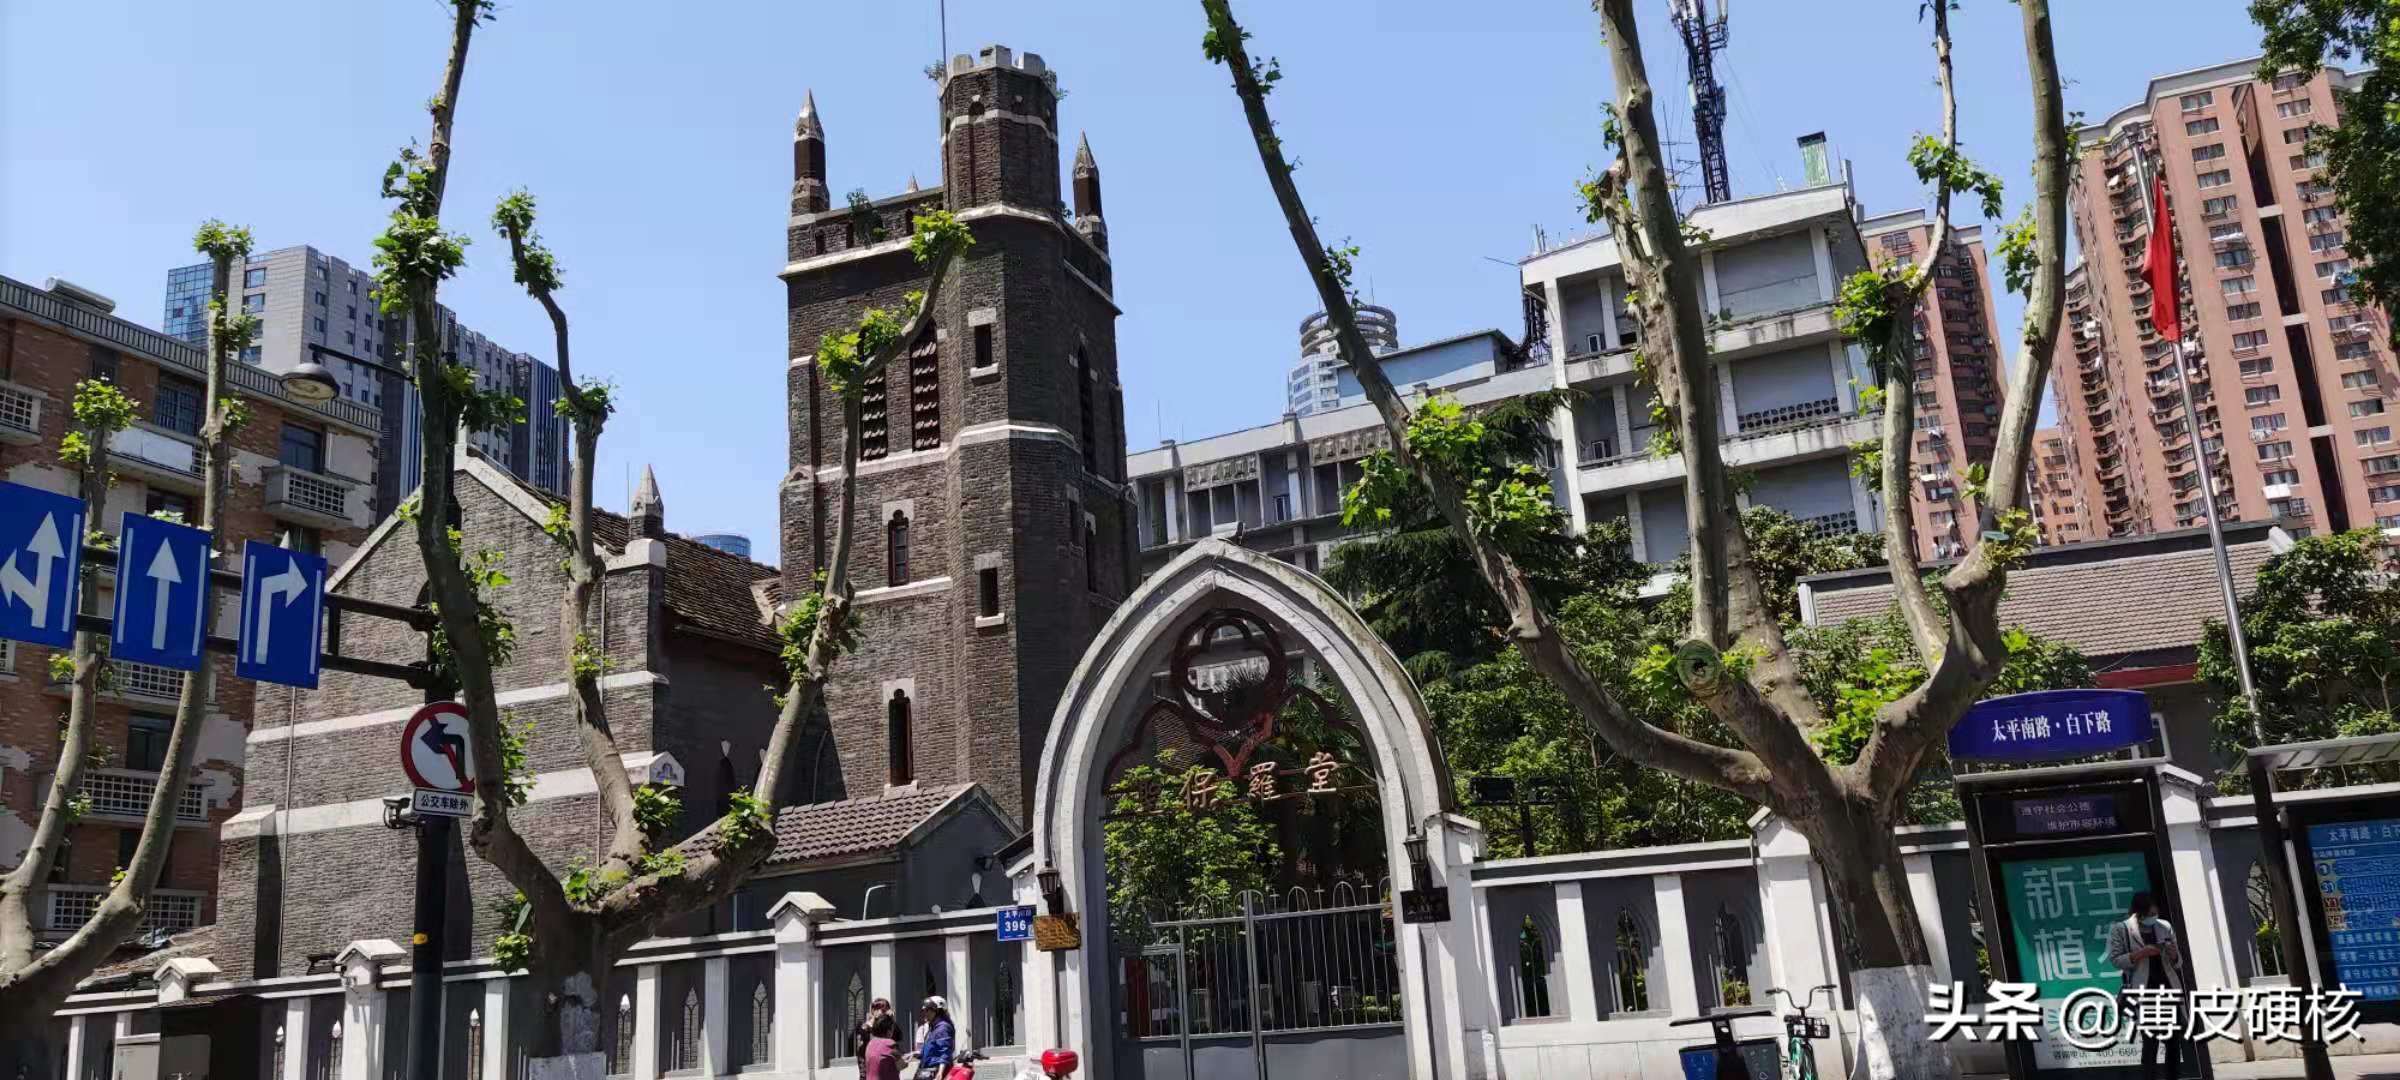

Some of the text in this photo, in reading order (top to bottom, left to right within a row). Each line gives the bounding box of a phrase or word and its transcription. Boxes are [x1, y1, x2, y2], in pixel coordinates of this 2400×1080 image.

[1992, 710, 2112, 743] 太平南路·白下路
[421, 793, 469, 811] 公交车除外
[2023, 862, 2133, 919] 新生
[1004, 920, 1026, 932] 396
